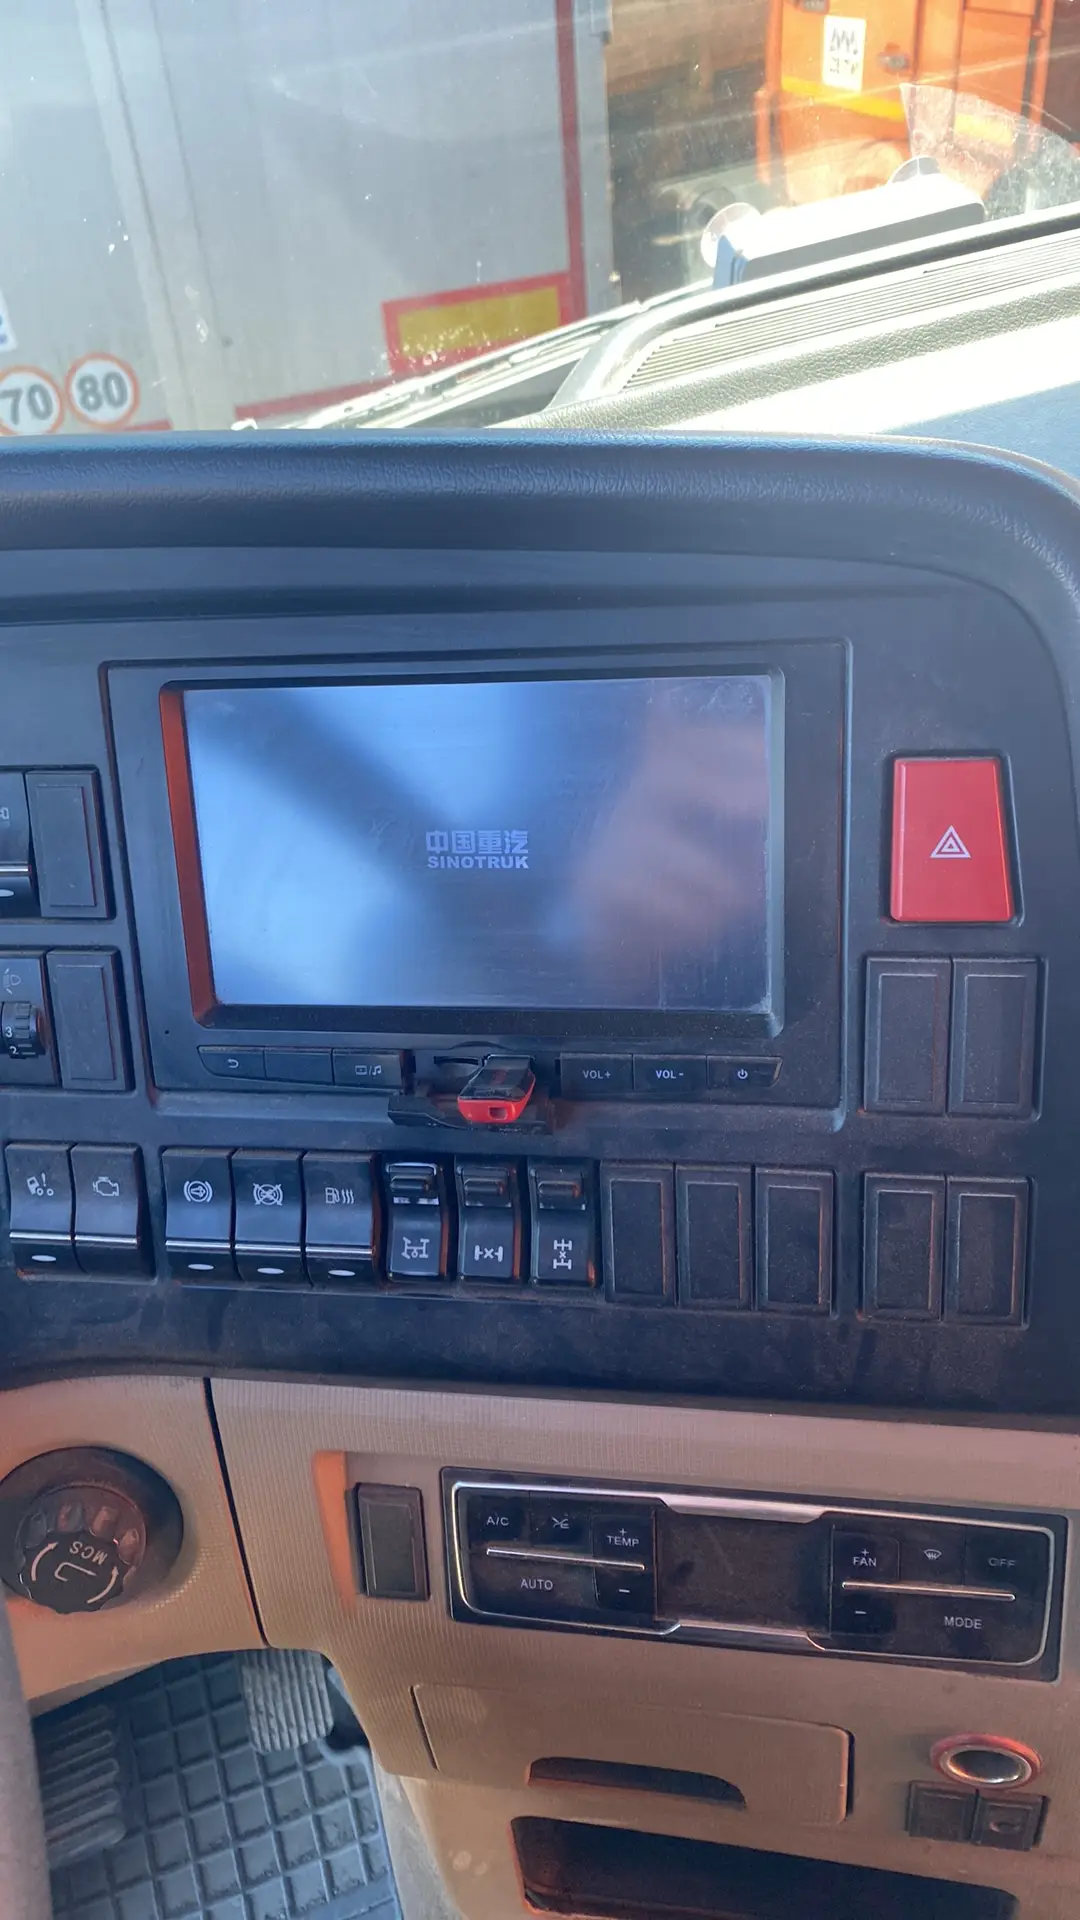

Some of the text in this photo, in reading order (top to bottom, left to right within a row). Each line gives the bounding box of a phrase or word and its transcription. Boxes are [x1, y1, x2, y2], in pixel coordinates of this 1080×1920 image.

[77, 372, 128, 412] 80
[0, 383, 53, 425] 70
[426, 830, 529, 854] 中国重汽
[427, 855, 529, 869] SINOTRUK
[5, 1026, 13, 1038] 3
[486, 1516, 510, 1526] A/C
[606, 1535, 640, 1547] TEMP
[69, 1541, 108, 1565] MCS
[852, 1556, 877, 1567] FAN
[987, 1557, 1016, 1568] OFF
[520, 1578, 554, 1590] AUTO
[943, 1616, 983, 1630] MODE
